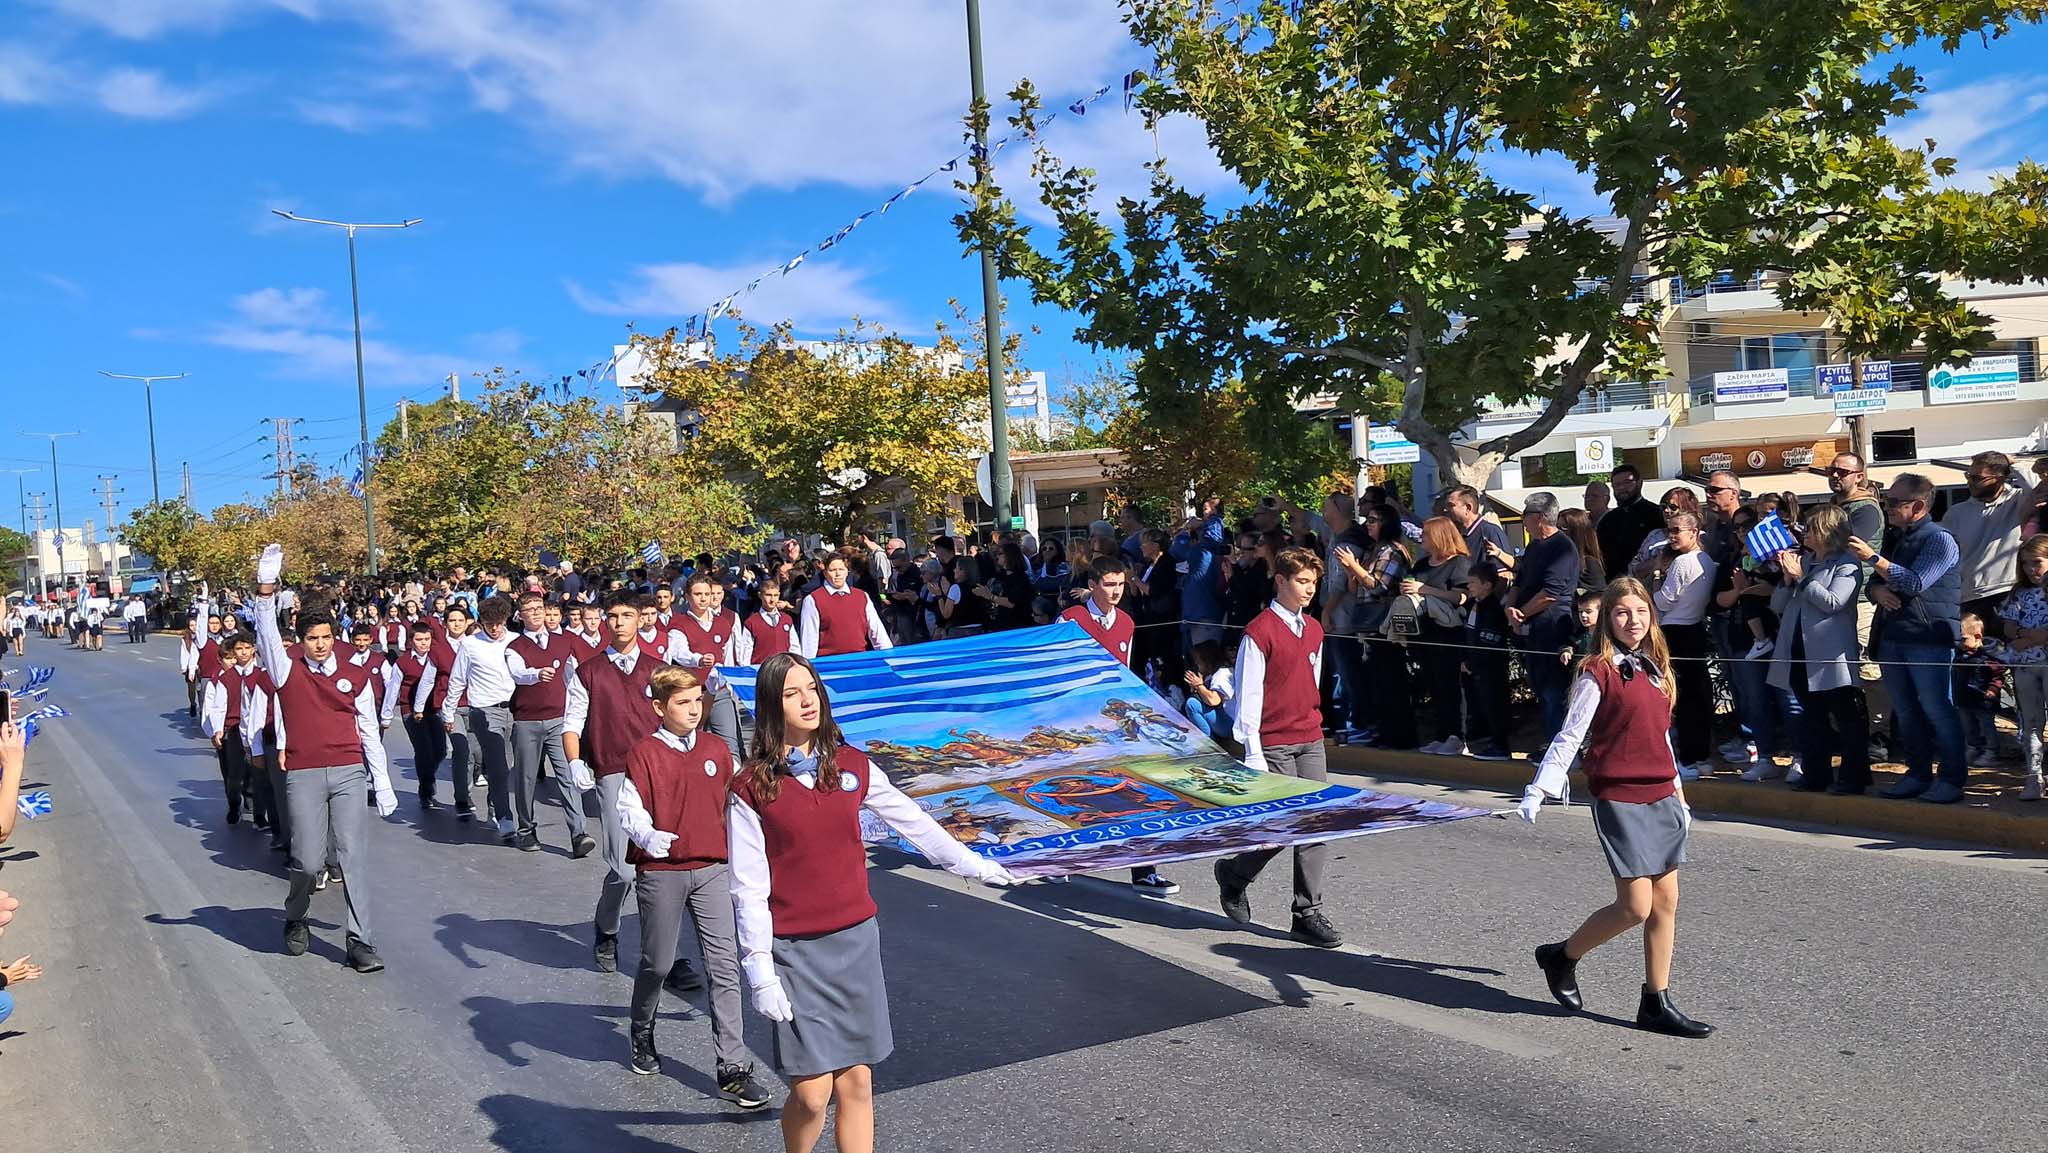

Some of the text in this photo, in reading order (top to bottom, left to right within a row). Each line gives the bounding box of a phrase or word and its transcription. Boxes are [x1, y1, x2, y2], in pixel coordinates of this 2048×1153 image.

[1826, 364, 1889, 375] ΣΥΓΓΕΥ ΚΕΛΥ
[1140, 792, 1327, 832] ΟΚΤΩΒΡΙΟΥ
